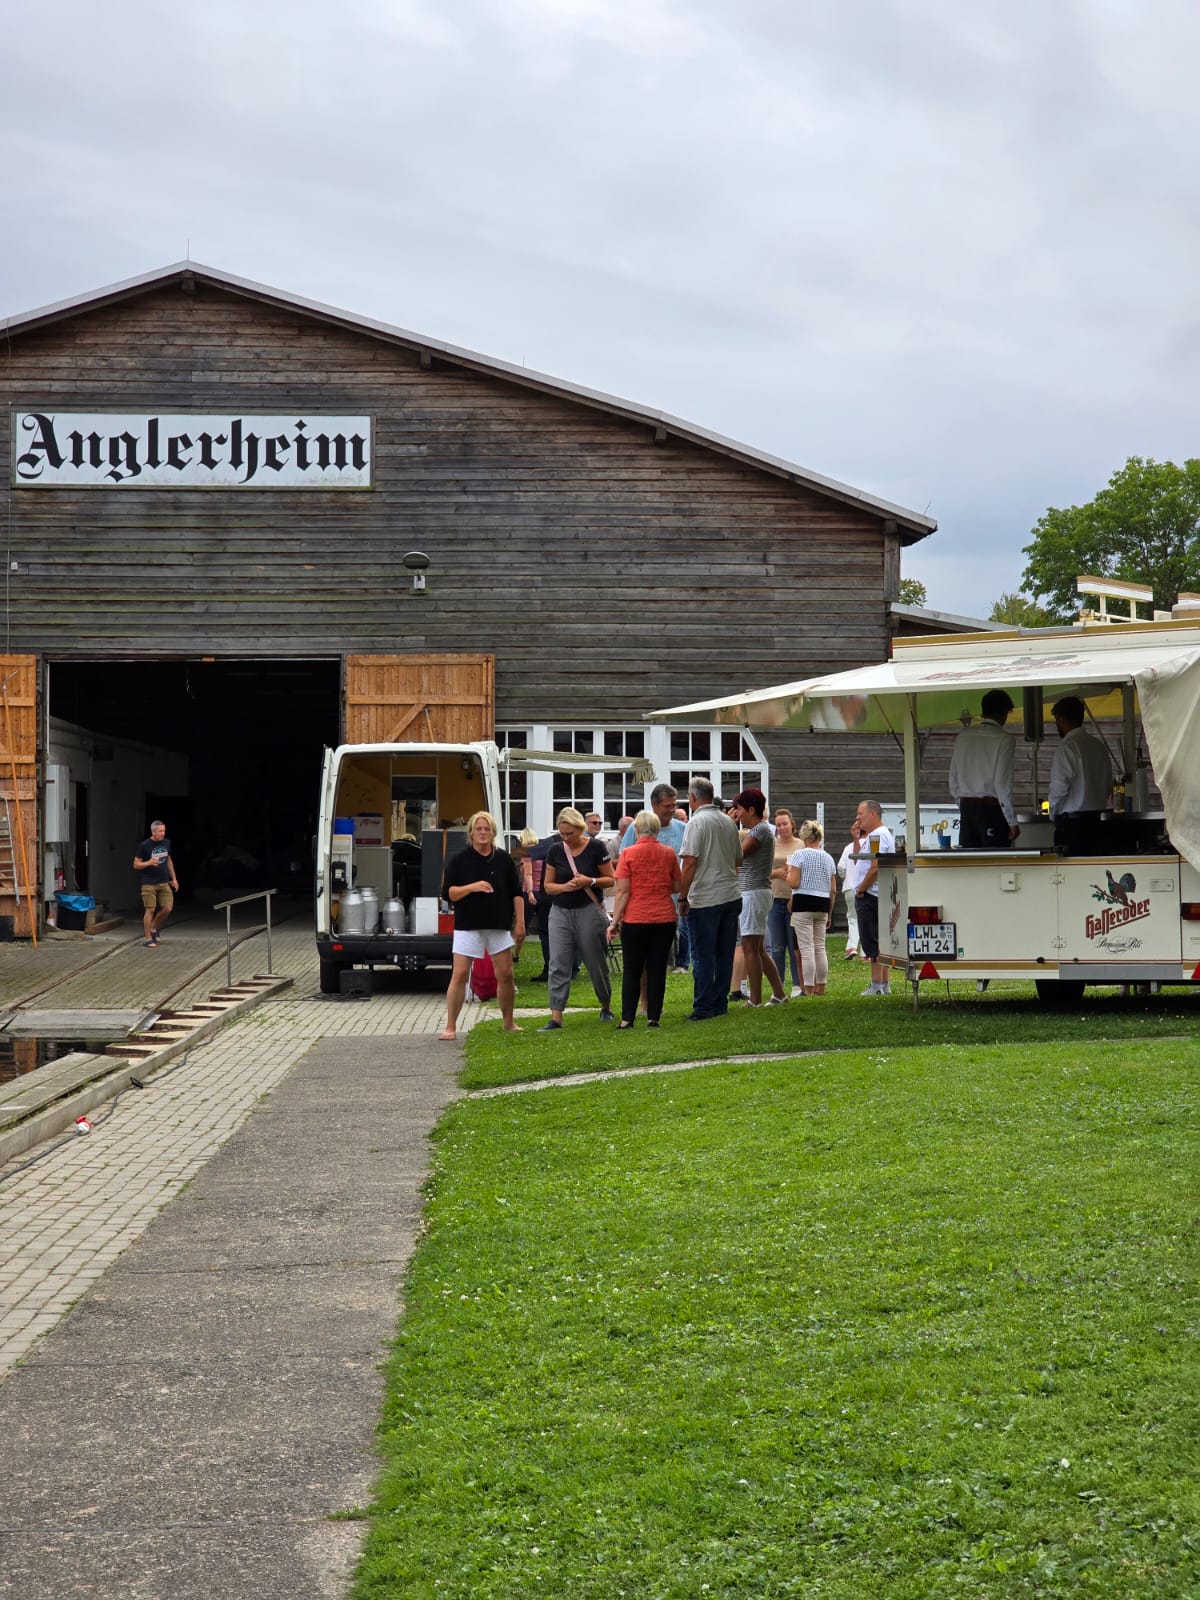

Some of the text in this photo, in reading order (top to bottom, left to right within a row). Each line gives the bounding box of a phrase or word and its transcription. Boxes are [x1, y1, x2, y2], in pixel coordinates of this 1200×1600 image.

[17, 413, 367, 484] Anglerheim
[915, 926, 938, 939] LWL
[914, 940, 930, 953] LH
[934, 940, 950, 953] 24
